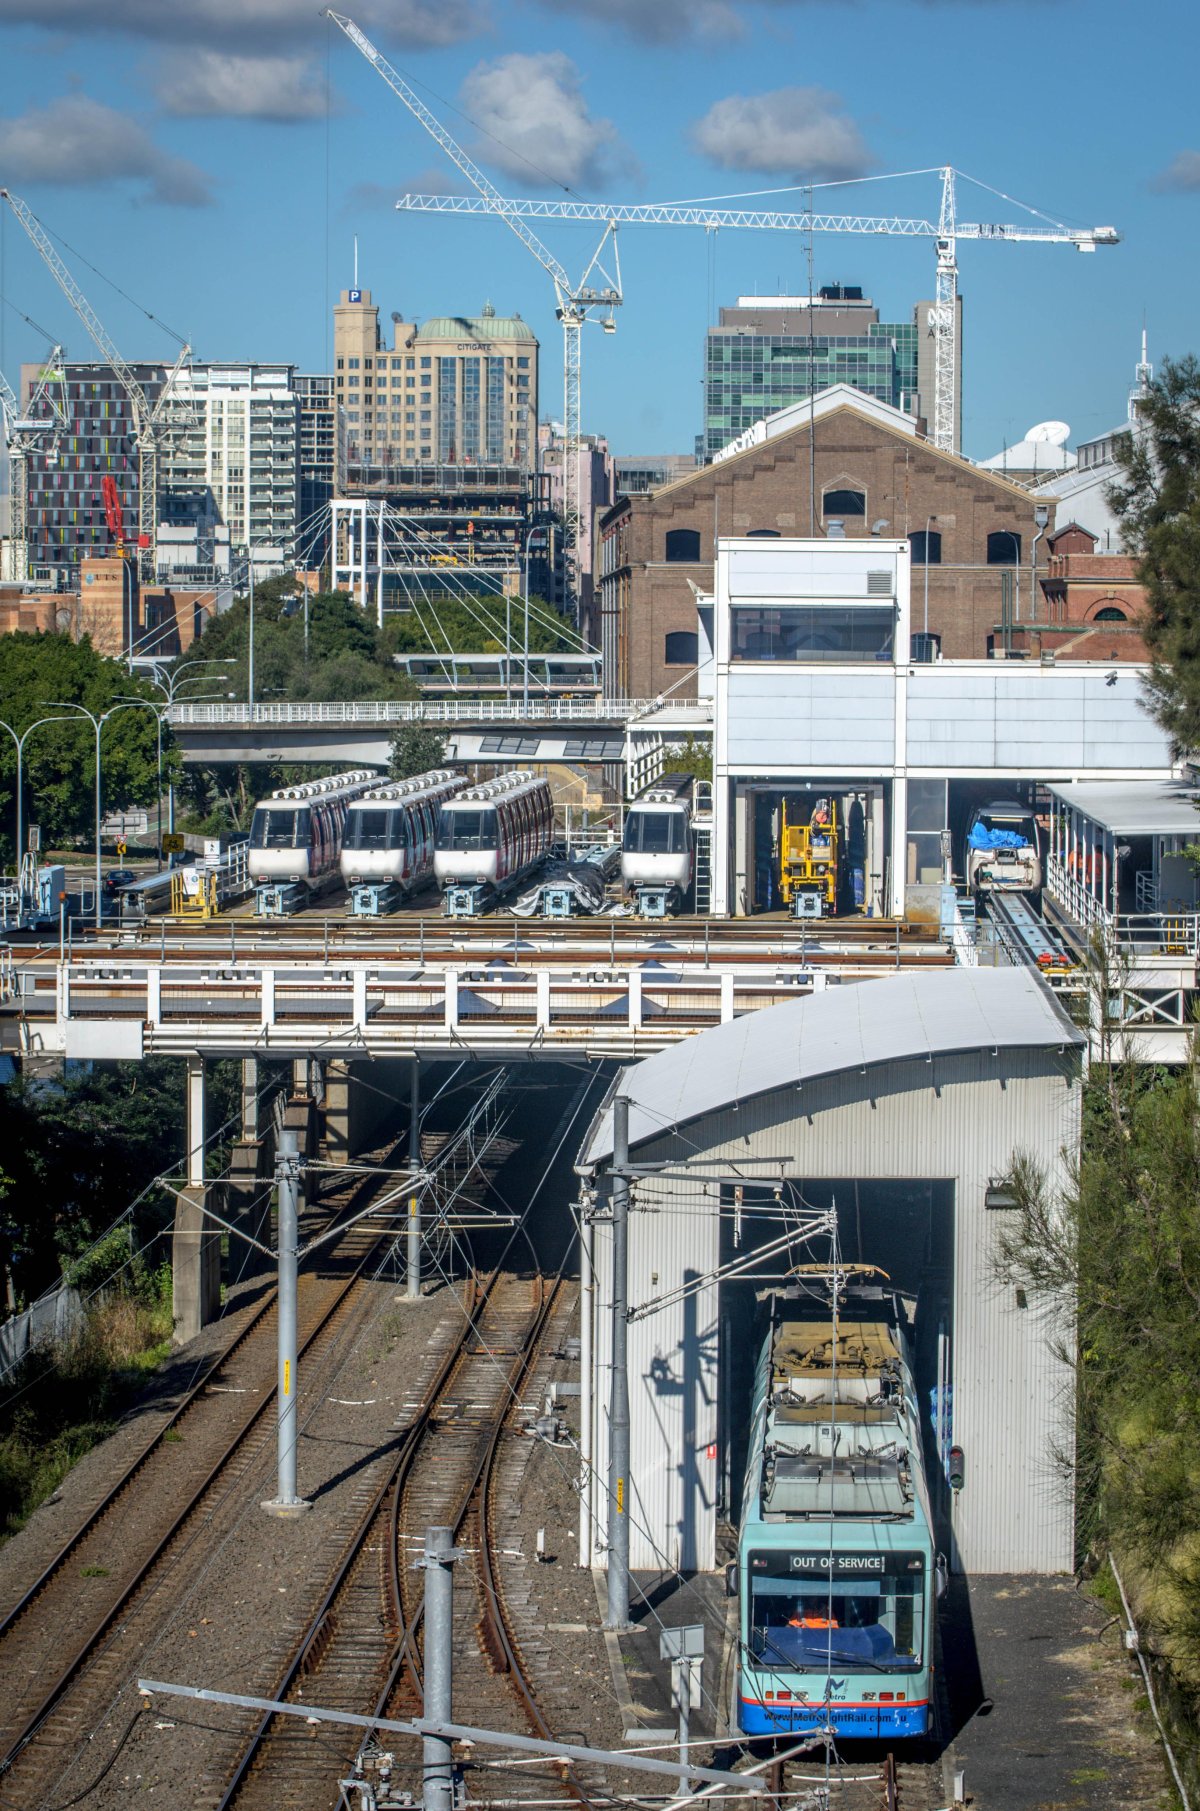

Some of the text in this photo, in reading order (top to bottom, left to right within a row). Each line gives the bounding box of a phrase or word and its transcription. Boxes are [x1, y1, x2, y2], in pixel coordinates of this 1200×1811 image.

[351, 291, 359, 302] P
[457, 343, 492, 351] CITIGATE
[793, 1557, 881, 1568] OUT OF SERVICE
[914, 1653, 922, 1665] 4
